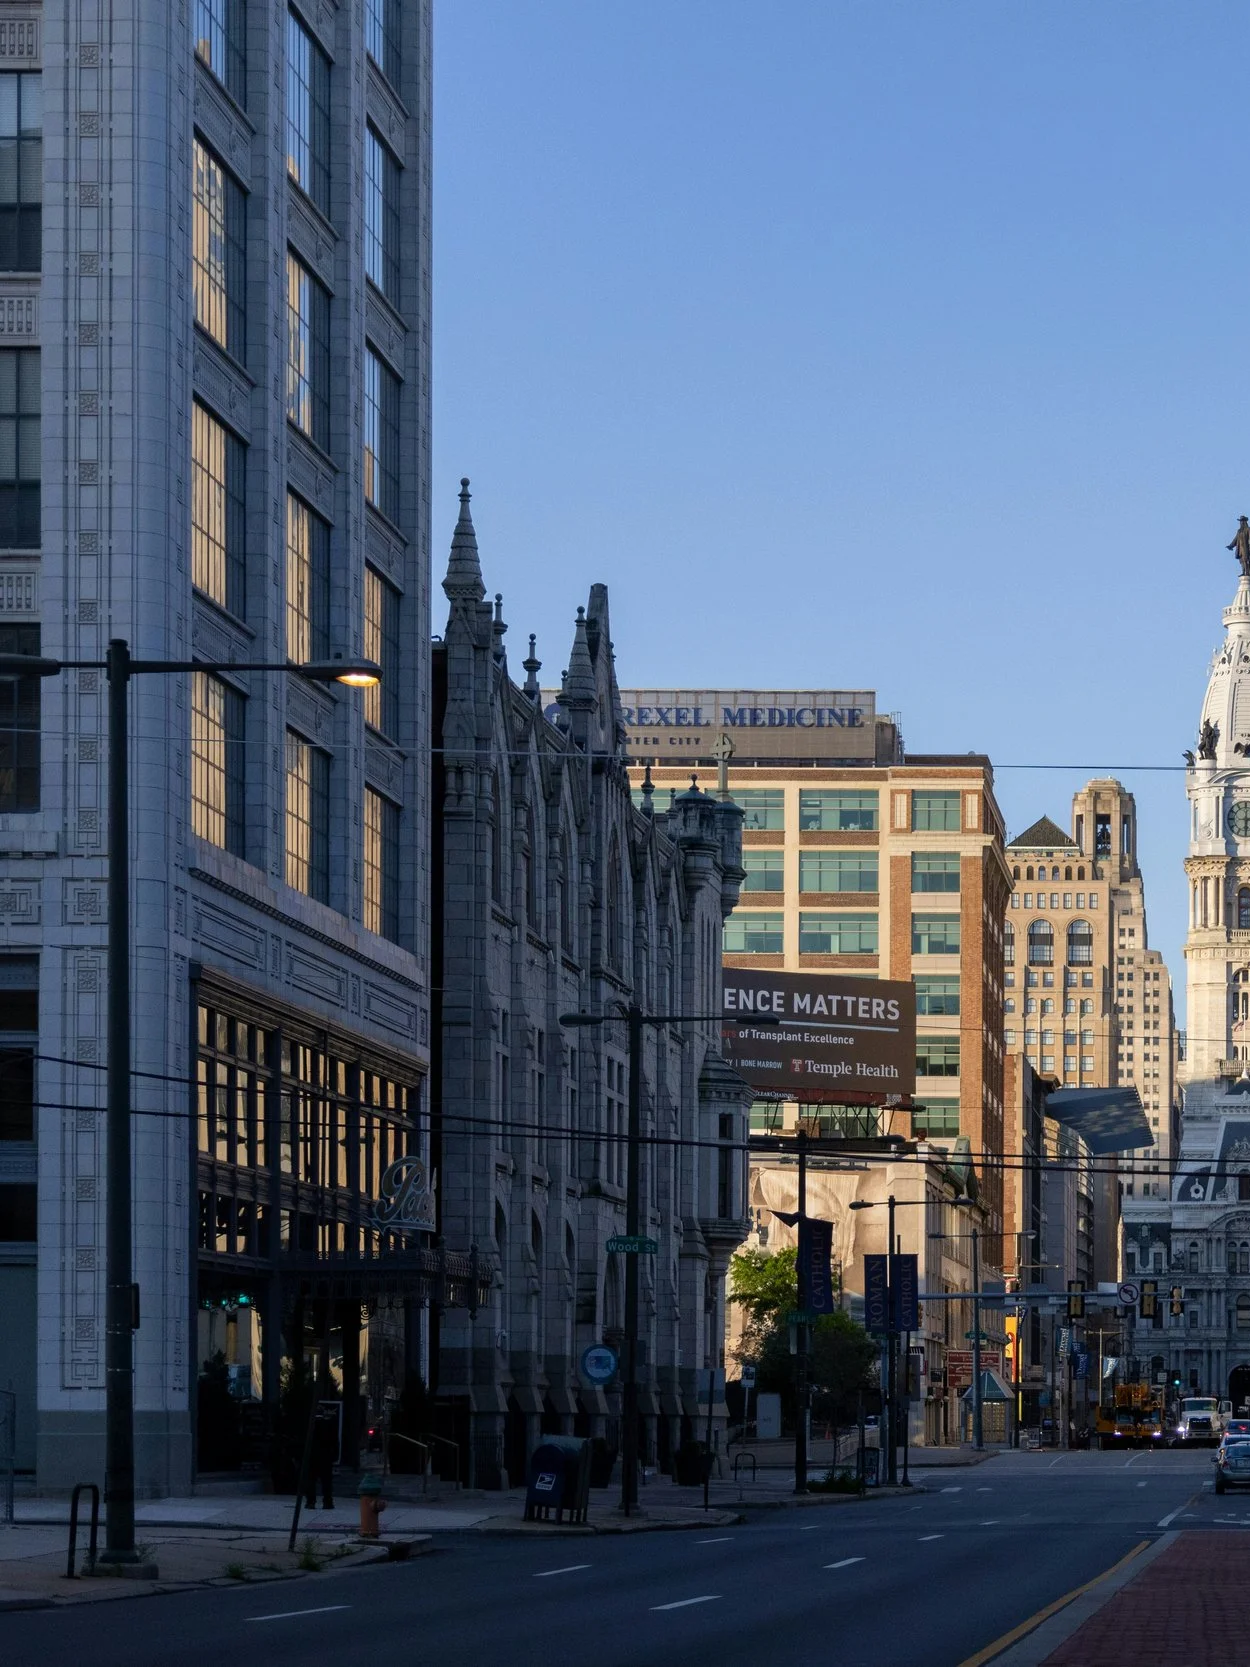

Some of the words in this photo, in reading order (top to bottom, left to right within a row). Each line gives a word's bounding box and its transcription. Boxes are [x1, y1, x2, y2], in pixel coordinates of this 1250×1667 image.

[722, 707, 865, 728] MEDICINE
[669, 736, 701, 745] CITY
[724, 988, 785, 1013] ENCE
[793, 992, 900, 1020] MATTERS
[739, 1028, 750, 1038] of
[751, 1029, 802, 1043] Transplant
[804, 1033, 854, 1045] Excellence
[741, 1059, 757, 1068] BONE
[757, 1060, 782, 1069] MARROW
[805, 1060, 852, 1078] Temple
[856, 1063, 899, 1078] Health
[608, 1241, 639, 1252] Wood
[644, 1244, 655, 1252] St
[812, 1227, 825, 1309] CATHOLIC
[870, 1260, 884, 1326] ROMAN
[900, 1257, 912, 1327] CATHOLIC
